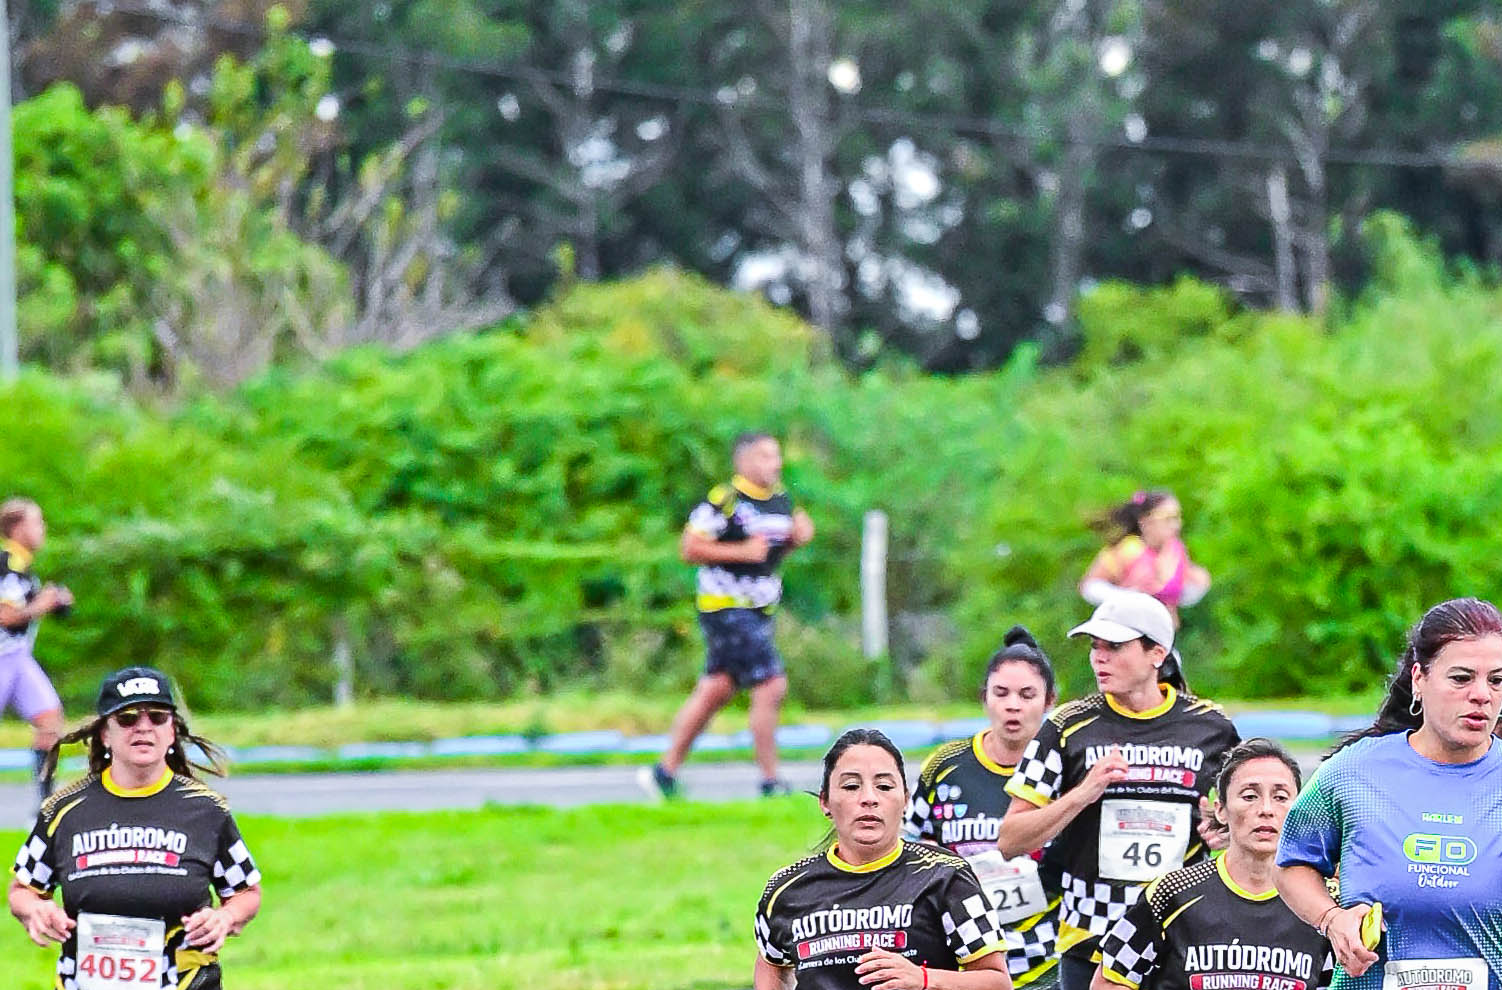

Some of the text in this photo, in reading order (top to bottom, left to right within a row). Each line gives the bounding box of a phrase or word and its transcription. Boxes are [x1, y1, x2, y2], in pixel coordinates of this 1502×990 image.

[1085, 743, 1204, 771] AUÓDROMO
[72, 822, 188, 857] AUTÓDROMO
[942, 812, 1001, 843] AUTÓD
[1122, 842, 1162, 867] 46
[1407, 863, 1471, 876] FUNCIONAL
[1417, 873, 1460, 888] Outdoor
[791, 903, 914, 943] AUTÓDROMO
[809, 933, 896, 956] RUNNING RACE
[79, 954, 157, 982] 4052
[1184, 938, 1313, 980] AUTÓDROMO
[1202, 974, 1260, 990] RUNNING
[1396, 965, 1473, 988] AUTÓDROMO
